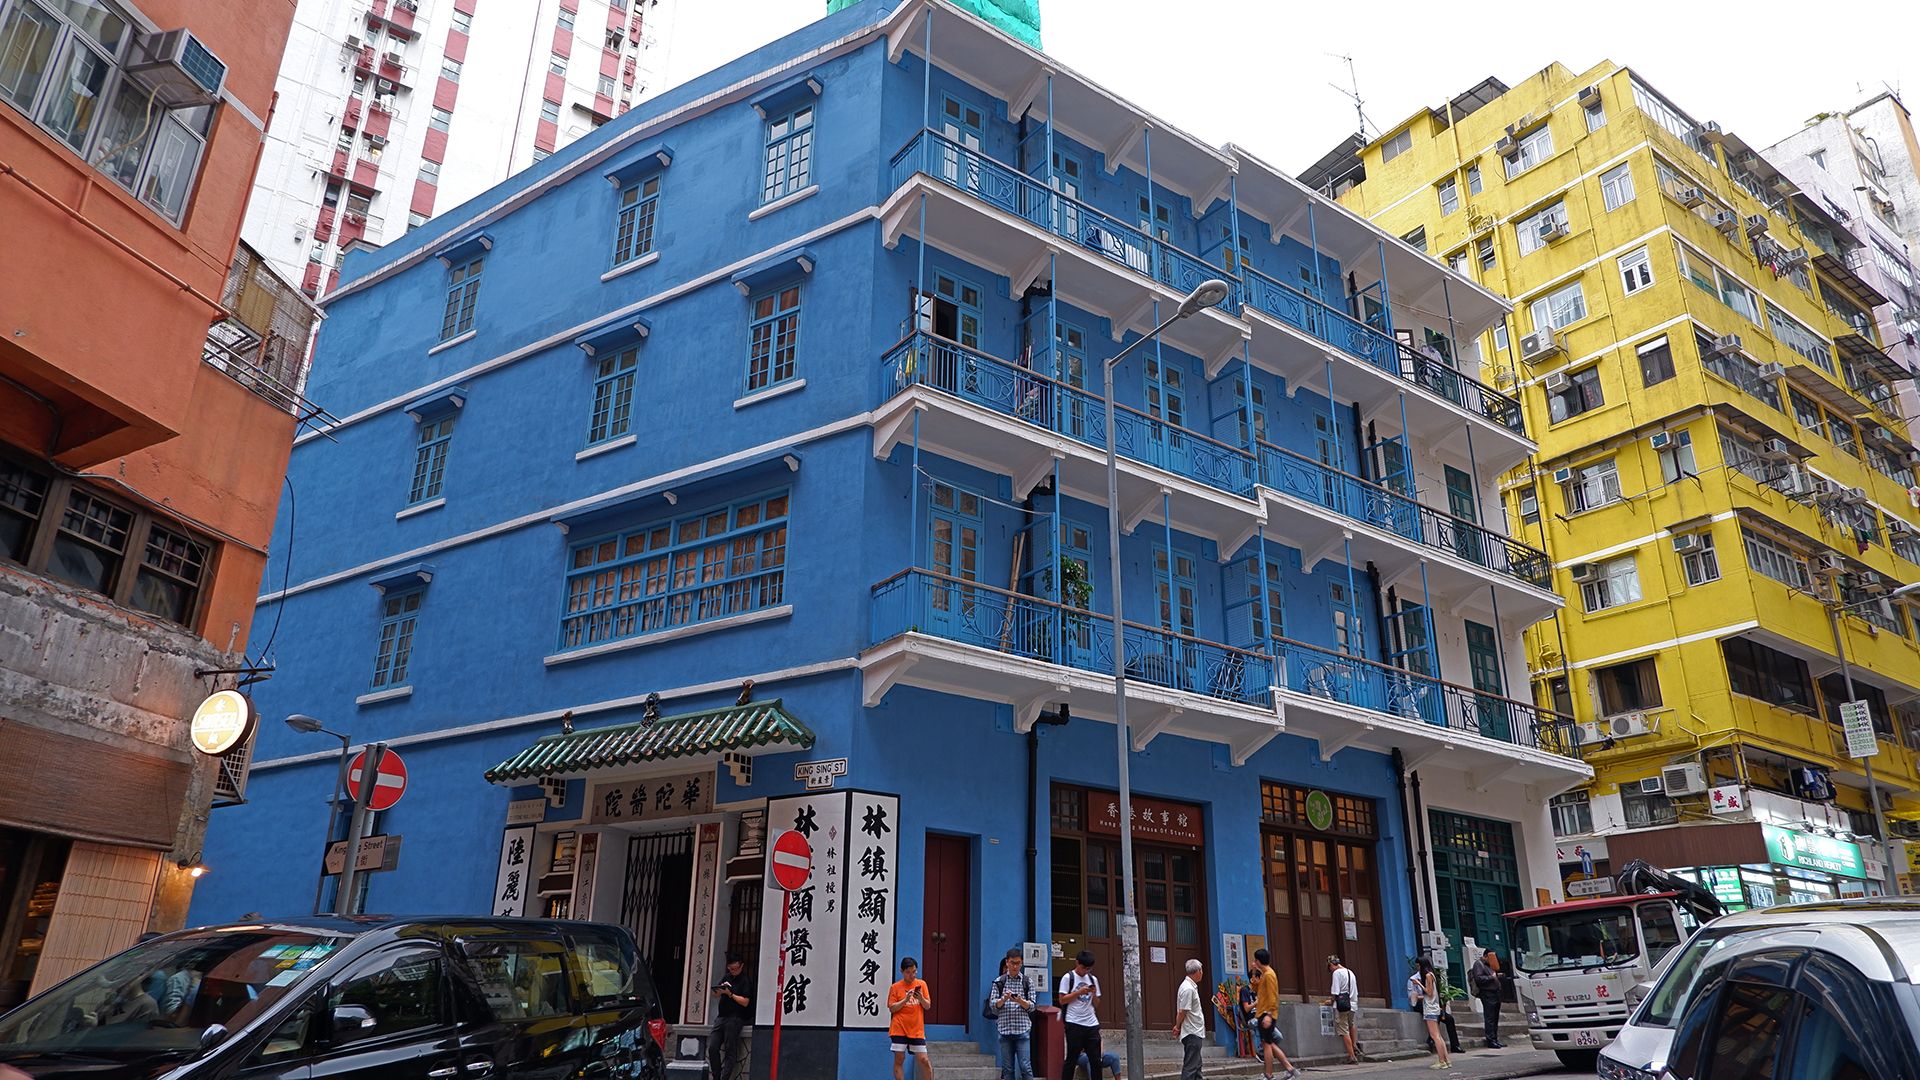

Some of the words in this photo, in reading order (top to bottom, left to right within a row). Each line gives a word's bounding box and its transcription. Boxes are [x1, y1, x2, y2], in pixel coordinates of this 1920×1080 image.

[797, 766, 814, 775] KING
[816, 764, 832, 774] SING
[834, 762, 843, 772] ST
[1100, 820, 1116, 828] Hong
[1138, 825, 1158, 833] House
[1170, 829, 1196, 838] Stories
[333, 846, 347, 855] King
[364, 840, 383, 851] Street
[1797, 855, 1823, 868] RICHLAND
